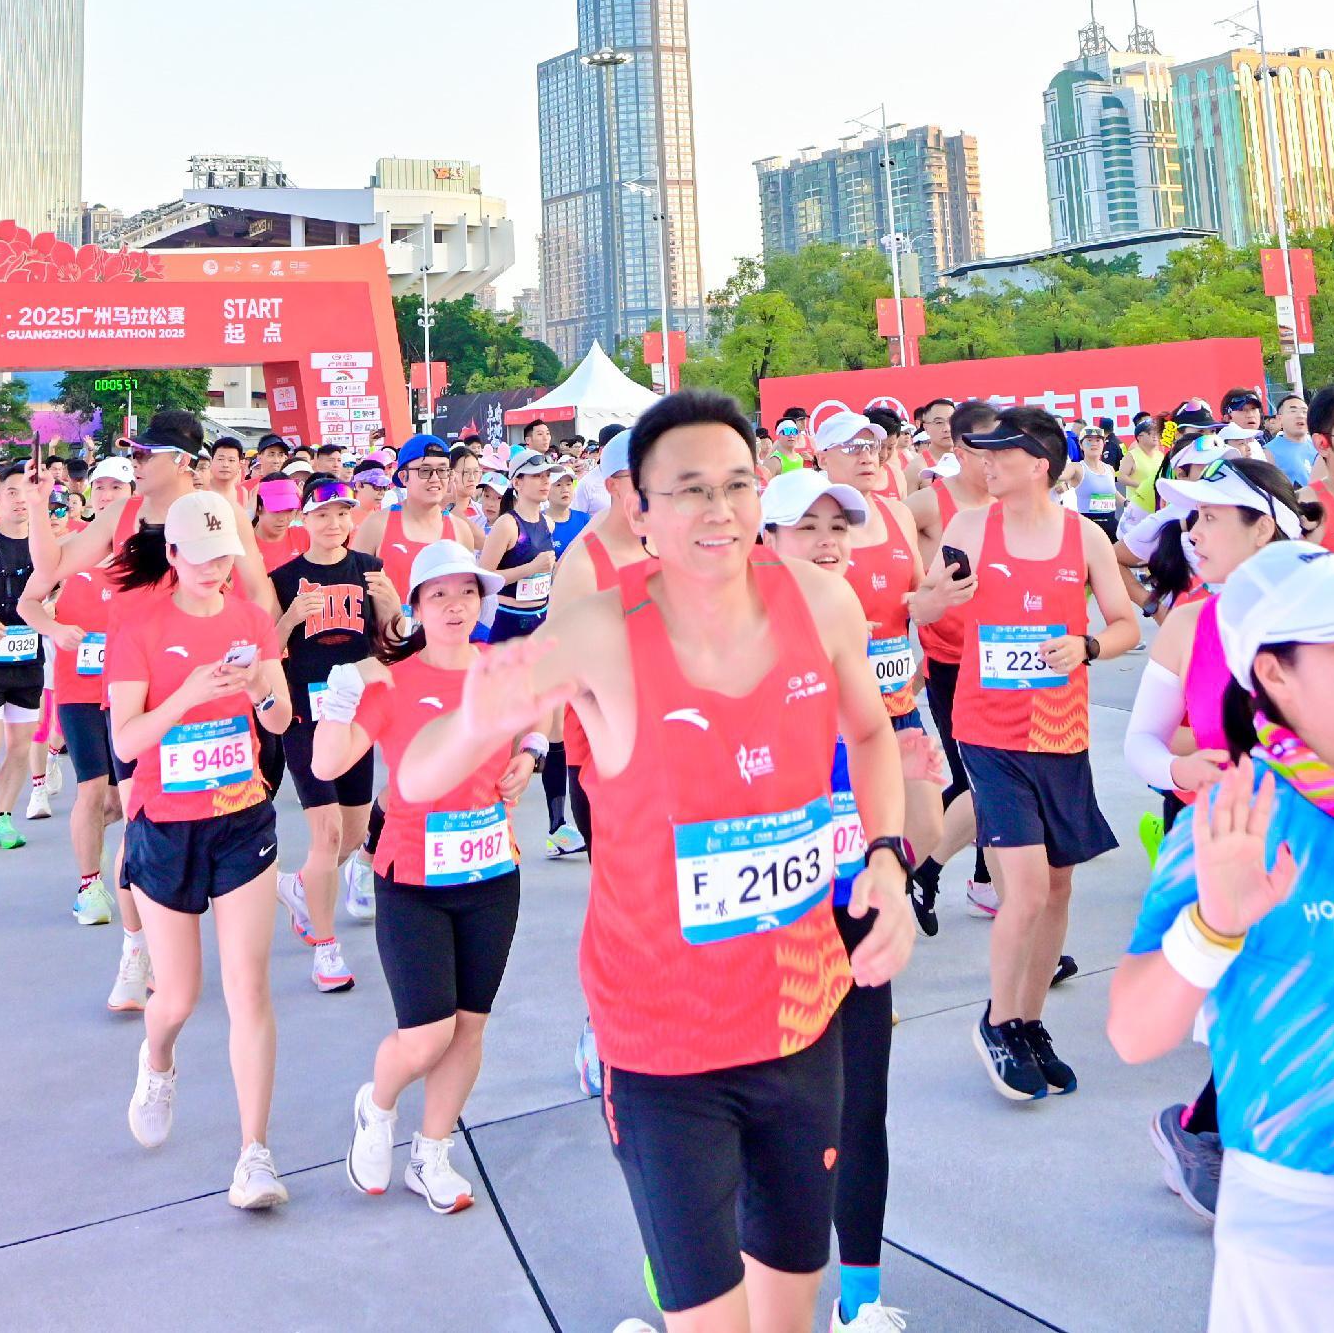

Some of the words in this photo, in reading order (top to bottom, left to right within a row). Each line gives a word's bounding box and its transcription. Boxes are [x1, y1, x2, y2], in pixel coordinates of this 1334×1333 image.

[18, 306, 185, 326] 2025广州马拉松赛
[223, 298, 283, 320] START
[6, 329, 87, 340] GUANGZHOU
[87, 328, 156, 340] MARATHON
[158, 328, 186, 339] 2025
[223, 322, 283, 344] 起点
[7, 638, 36, 653] 0329
[83, 649, 89, 658] F
[876, 657, 911, 680] 0007
[985, 651, 993, 664] F
[1006, 651, 1053, 672] 223
[169, 753, 178, 768] F
[192, 742, 246, 772] 9465
[434, 842, 444, 857] E
[460, 831, 503, 864] 9187
[693, 873, 709, 897] F
[737, 847, 821, 905] 2163
